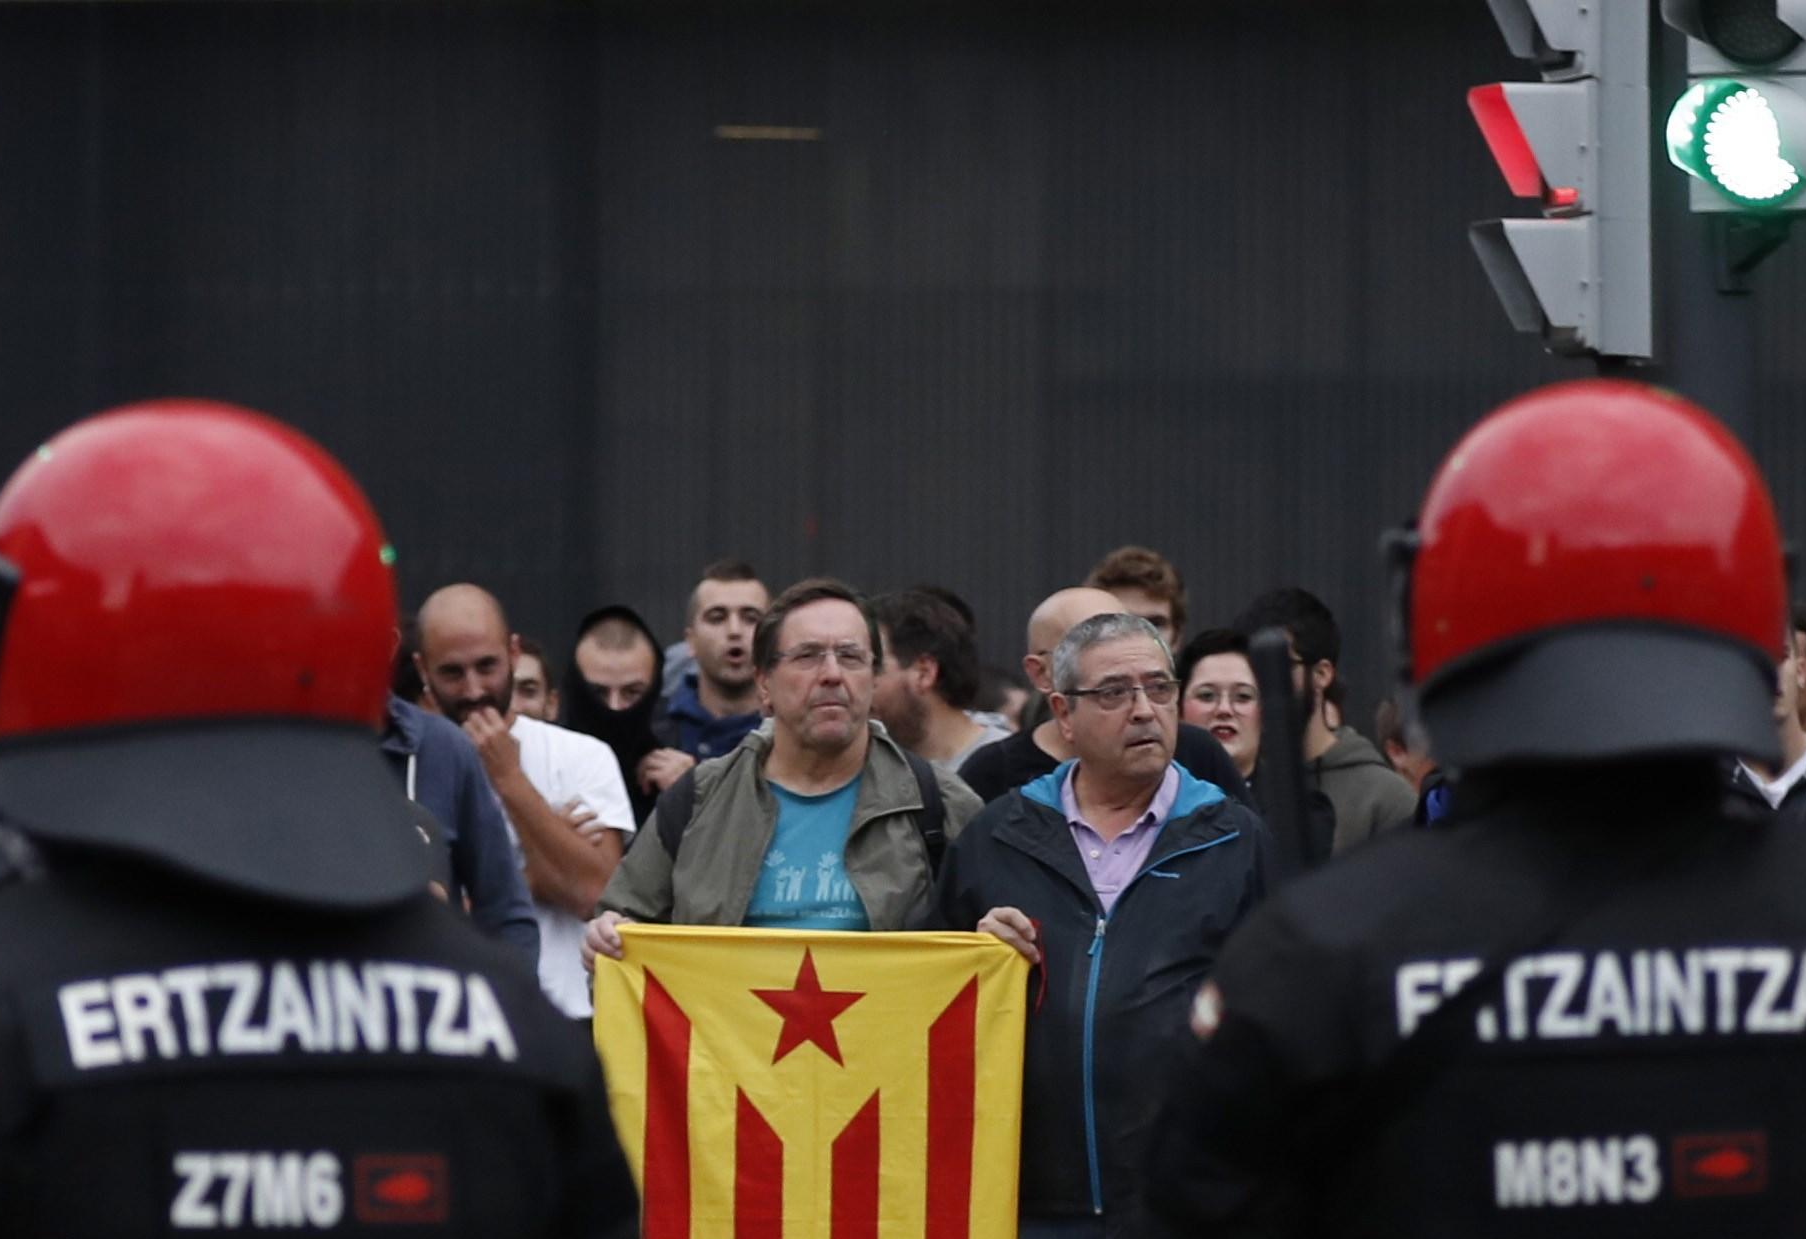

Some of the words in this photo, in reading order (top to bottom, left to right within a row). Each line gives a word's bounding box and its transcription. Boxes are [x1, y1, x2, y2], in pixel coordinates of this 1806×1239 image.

[57, 961, 518, 1069] ERTZAINTZA
[170, 1151, 344, 1228] Z7M6
[1495, 1136, 1661, 1208] M8N3
